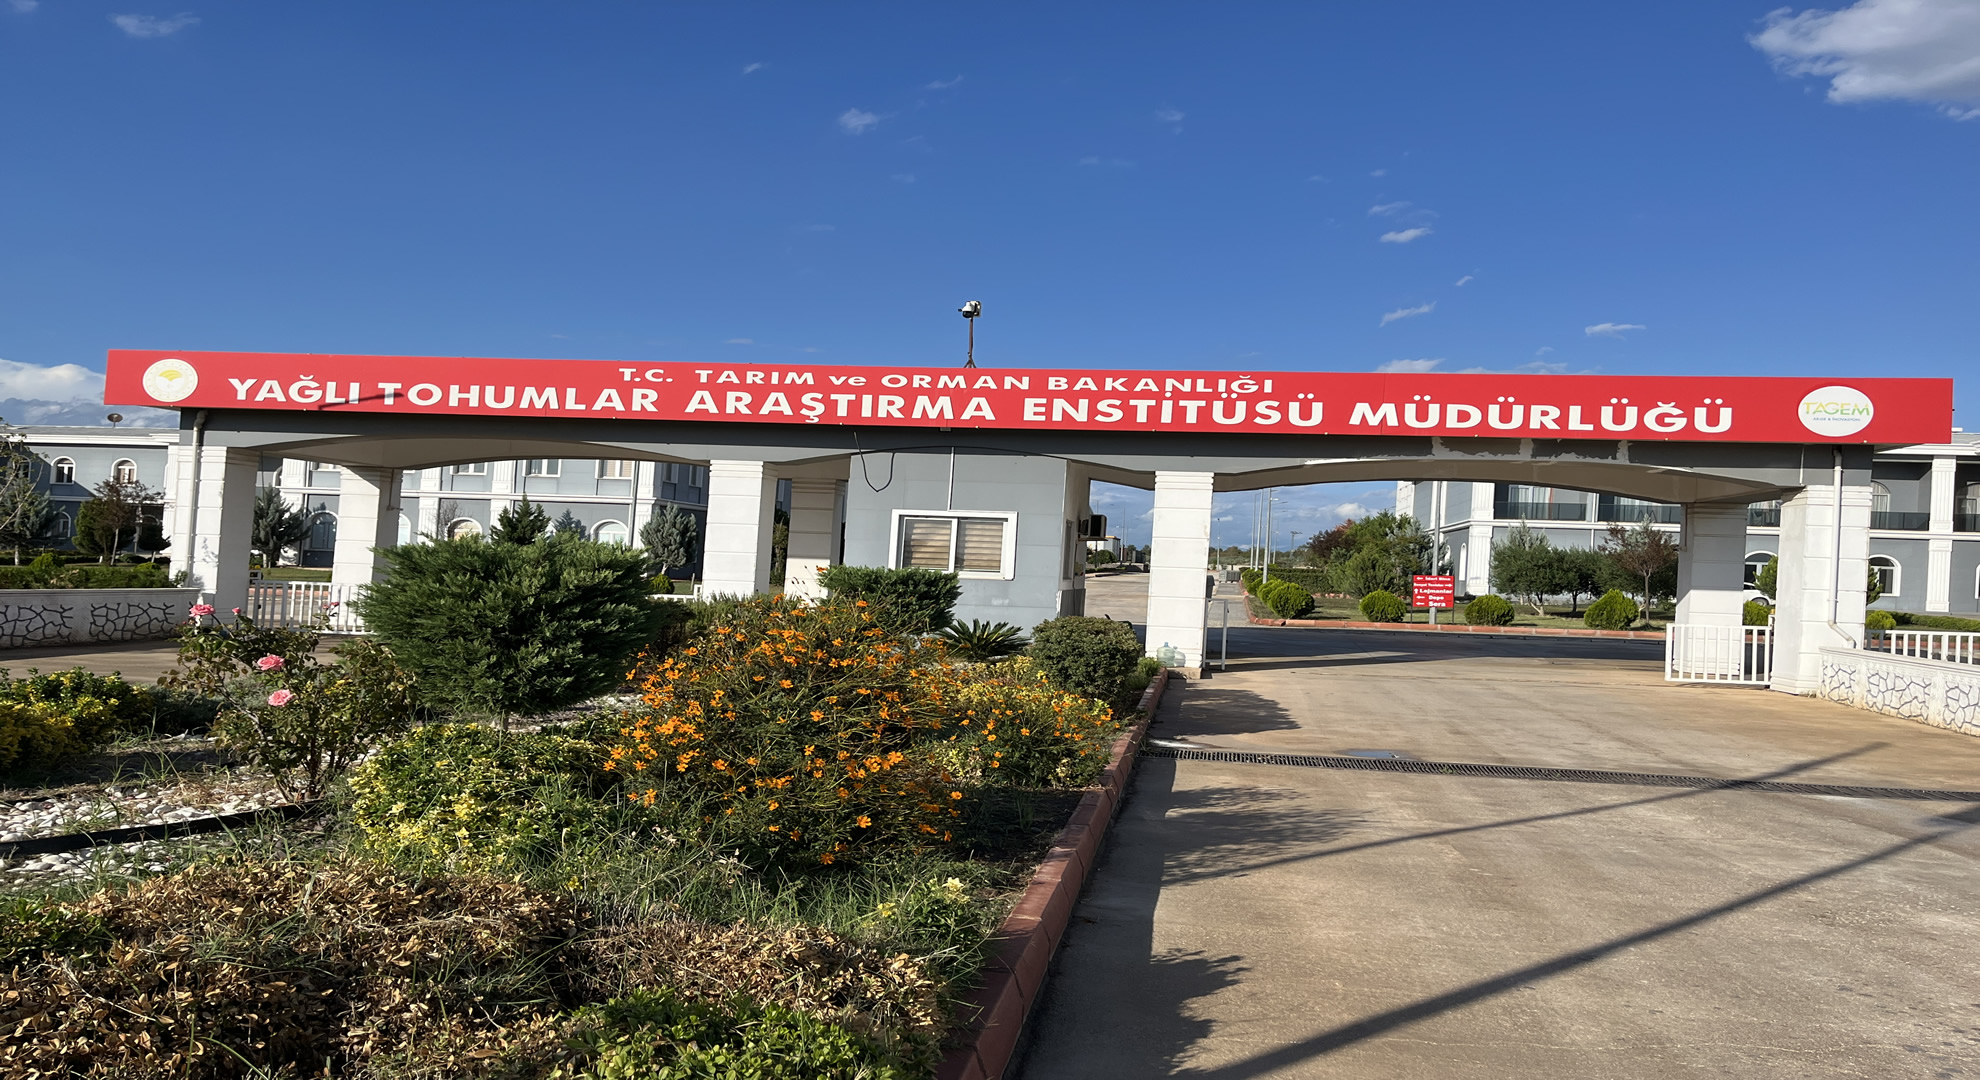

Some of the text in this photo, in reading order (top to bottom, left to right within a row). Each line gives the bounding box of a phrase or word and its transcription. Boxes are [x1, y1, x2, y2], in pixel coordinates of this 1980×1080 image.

[619, 367, 1273, 394] T.C. TARIM ve ORMAN BAKANLIĞI
[228, 374, 1733, 434] YAĞLI TOHUMLAR ARAŞTIRMA ENSTİTÜSÜ MÜDÜRLÜĞÜ
[1803, 401, 1870, 416] TAGEM
